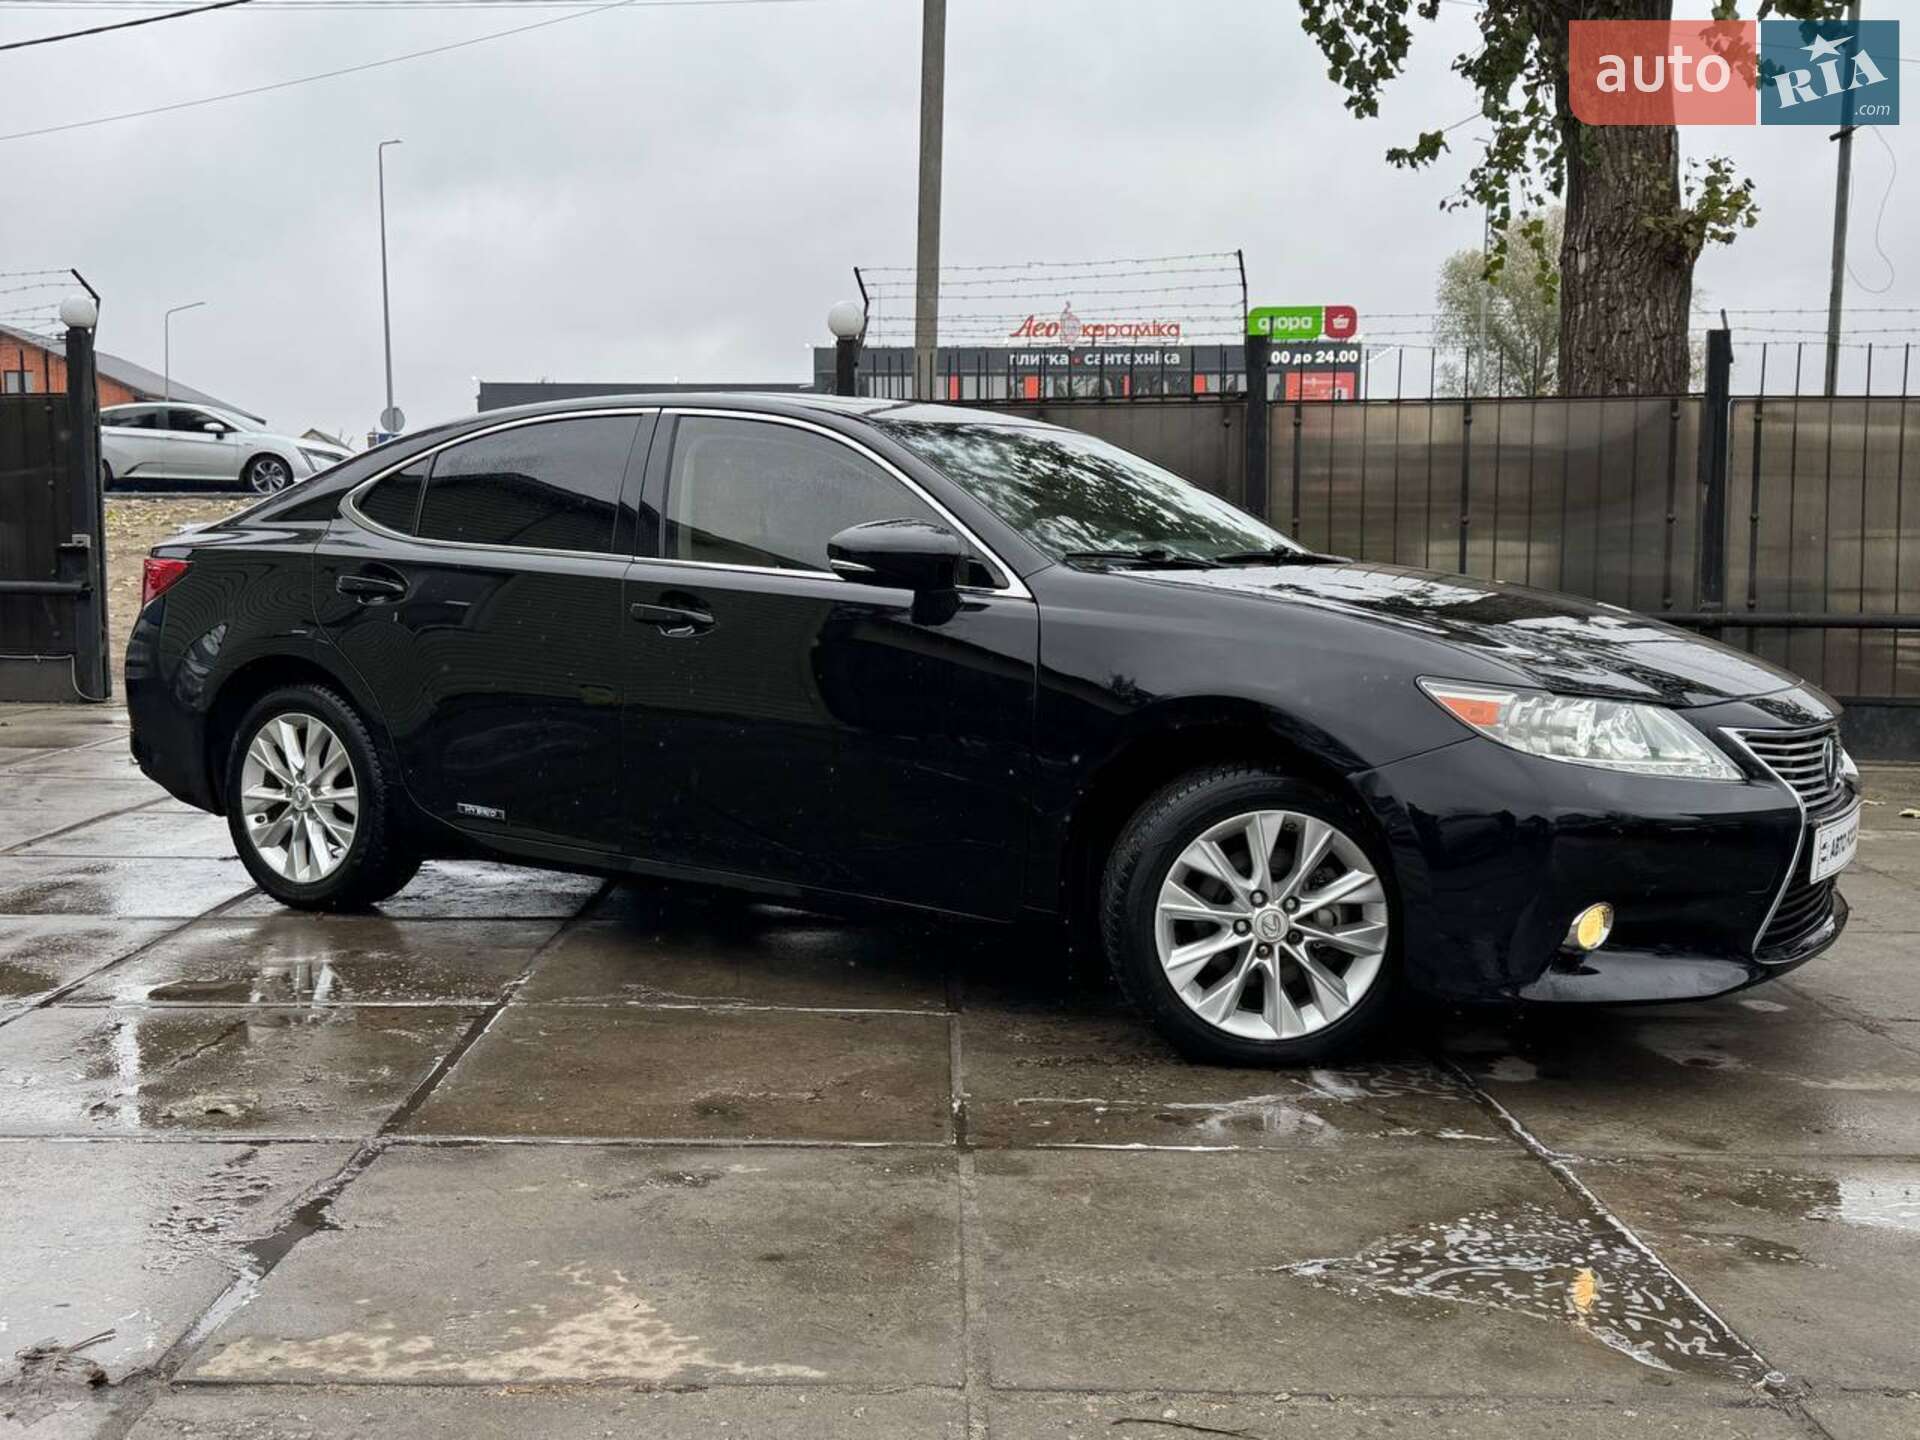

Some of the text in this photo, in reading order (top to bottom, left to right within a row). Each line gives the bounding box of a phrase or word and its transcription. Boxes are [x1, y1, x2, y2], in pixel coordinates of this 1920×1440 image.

[1010, 314, 1181, 339] Лео кераміка
[1315, 350, 1359, 363] 24.00
